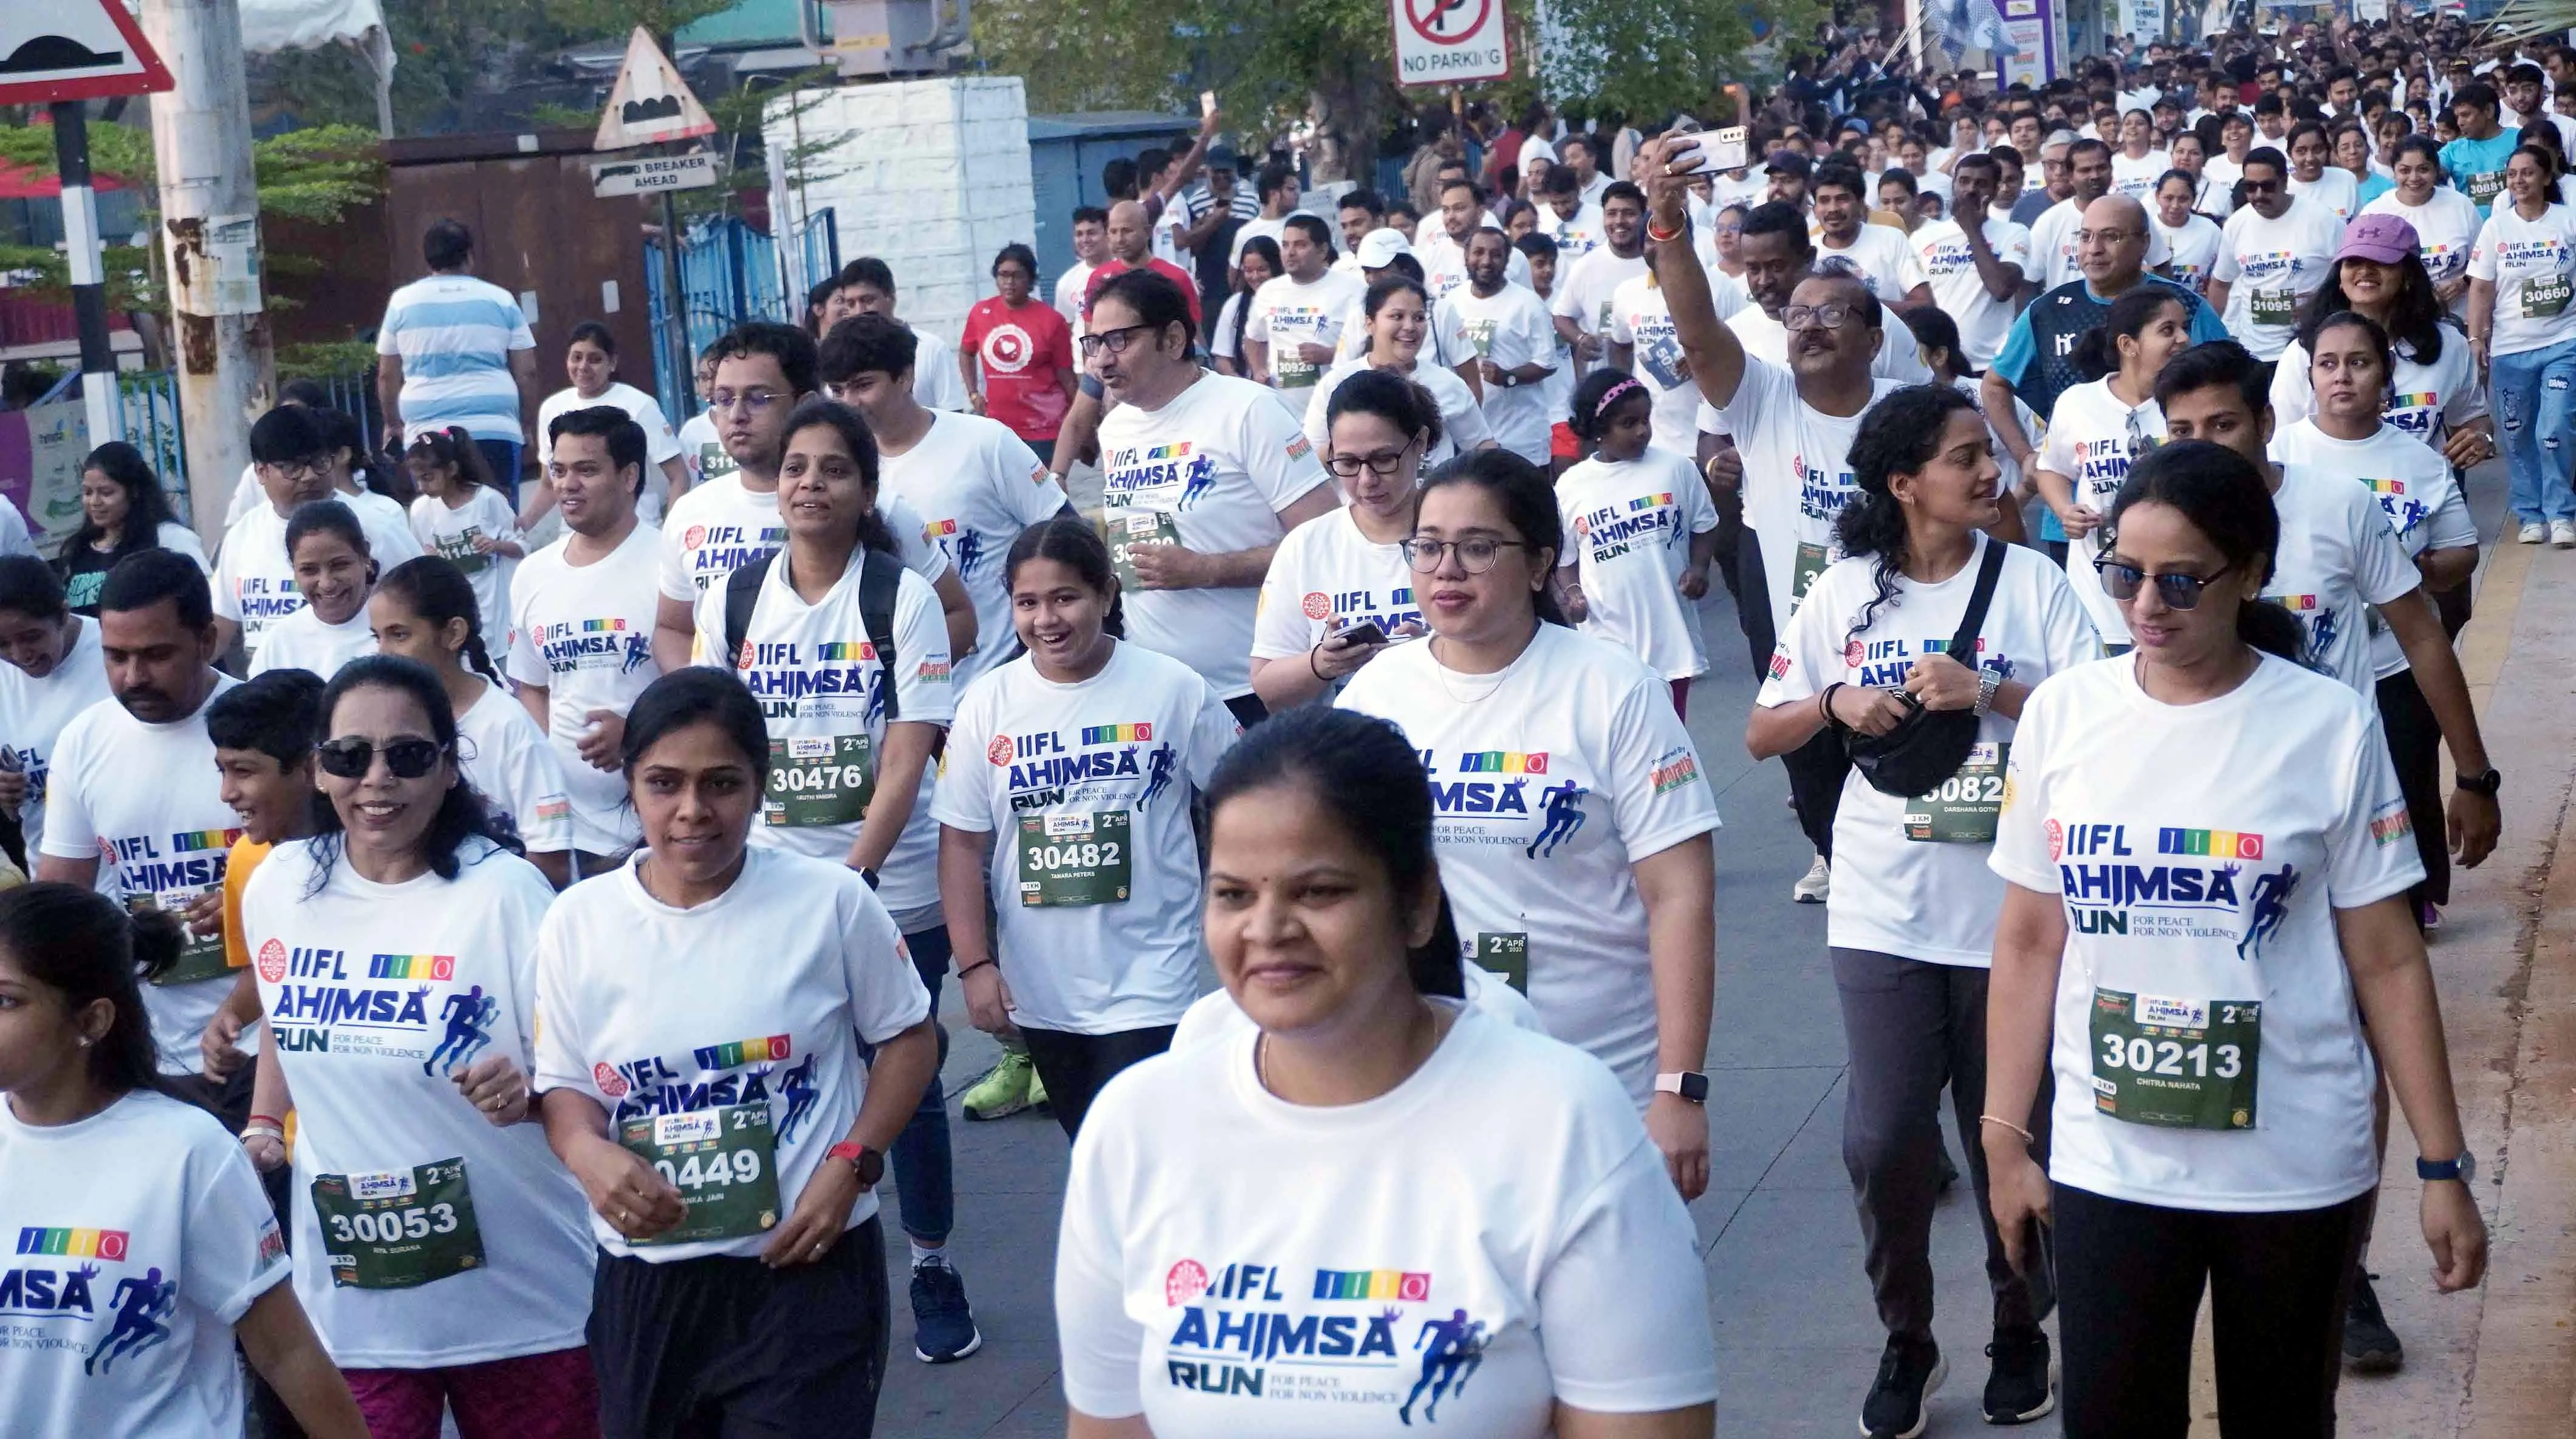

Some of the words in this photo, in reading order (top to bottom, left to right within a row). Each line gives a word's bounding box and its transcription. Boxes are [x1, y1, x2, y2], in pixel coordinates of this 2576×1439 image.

[1404, 55, 1427, 71] NO
[645, 157, 706, 173] BREAKER
[635, 174, 678, 187] AHEAD
[1930, 254, 1974, 265] AHIMS
[2506, 249, 2554, 260] AHIMSA
[2245, 259, 2287, 271] AHIMSA
[2253, 300, 2291, 311] 31095
[2526, 287, 2570, 304] 30660
[1273, 315, 1312, 325] AHIMSA
[1642, 315, 1658, 324] IIFL
[1637, 326, 1676, 336] AHIMS
[1114, 447, 1140, 467] IIFL
[1588, 505, 1621, 528] IIFL
[708, 527, 745, 544] IIFL
[1589, 508, 1669, 548] AHIMSA
[1593, 541, 1631, 570] RUN
[243, 579, 270, 594] IIFL
[1334, 591, 1377, 613] IIFL
[245, 620, 262, 633] UN
[547, 622, 574, 641] IIFL
[543, 636, 620, 661] AHIMSA
[758, 643, 801, 665] IIFL
[1868, 640, 1908, 661] IIFL
[748, 667, 866, 700] AHIMSA
[1860, 661, 1914, 687] AHI
[1017, 731, 1066, 758] IIFL
[772, 764, 863, 792] 30476
[1009, 749, 1140, 790] AHIMSA
[1010, 788, 1064, 812] RUN
[1082, 787, 1107, 797] PEACE
[1101, 791, 1139, 800] VIOLENCE
[1428, 780, 1529, 814] MSA
[1453, 825, 1485, 836] PEACE
[1478, 836, 1531, 845] VIOLENCE
[2067, 824, 2132, 856] IIFL
[1029, 842, 1120, 871] 30482
[2060, 863, 2241, 907] AHIMSA
[2133, 915, 2156, 926] FOR
[2157, 916, 2194, 927] PEACE
[2133, 927, 2156, 937] FOR
[2157, 927, 2184, 938] NON
[2186, 928, 2239, 941] VIOLENCE
[290, 947, 348, 980] IIFL
[372, 956, 453, 979] JITO
[273, 983, 427, 1026] AHIMSA
[2148, 1006, 2188, 1017] AHIMSA
[333, 1035, 351, 1045] FOR
[352, 1035, 384, 1045] PEACE
[332, 1044, 351, 1054] FOR
[352, 1045, 373, 1055] NON
[375, 1046, 427, 1060] VIOLENCE
[2102, 1034, 2242, 1079] 30213
[2136, 1077, 2167, 1088] CHITRA
[2167, 1080, 2201, 1091] NAHATA
[331, 1203, 458, 1242] 30053
[24, 1229, 124, 1259] JITO
[0, 1268, 94, 1313] MSA
[1206, 1263, 1283, 1301] IIFL
[12, 1326, 45, 1338] PEACE
[1170, 1305, 1397, 1362] AHIMSA
[1167, 1360, 1265, 1396] RUN
[1270, 1374, 1295, 1386] FOR
[1299, 1375, 1341, 1387] PEACE
[1270, 1389, 1294, 1400] FOR
[1298, 1390, 1327, 1401] NON
[1331, 1390, 1398, 1404] VIOLENCE
